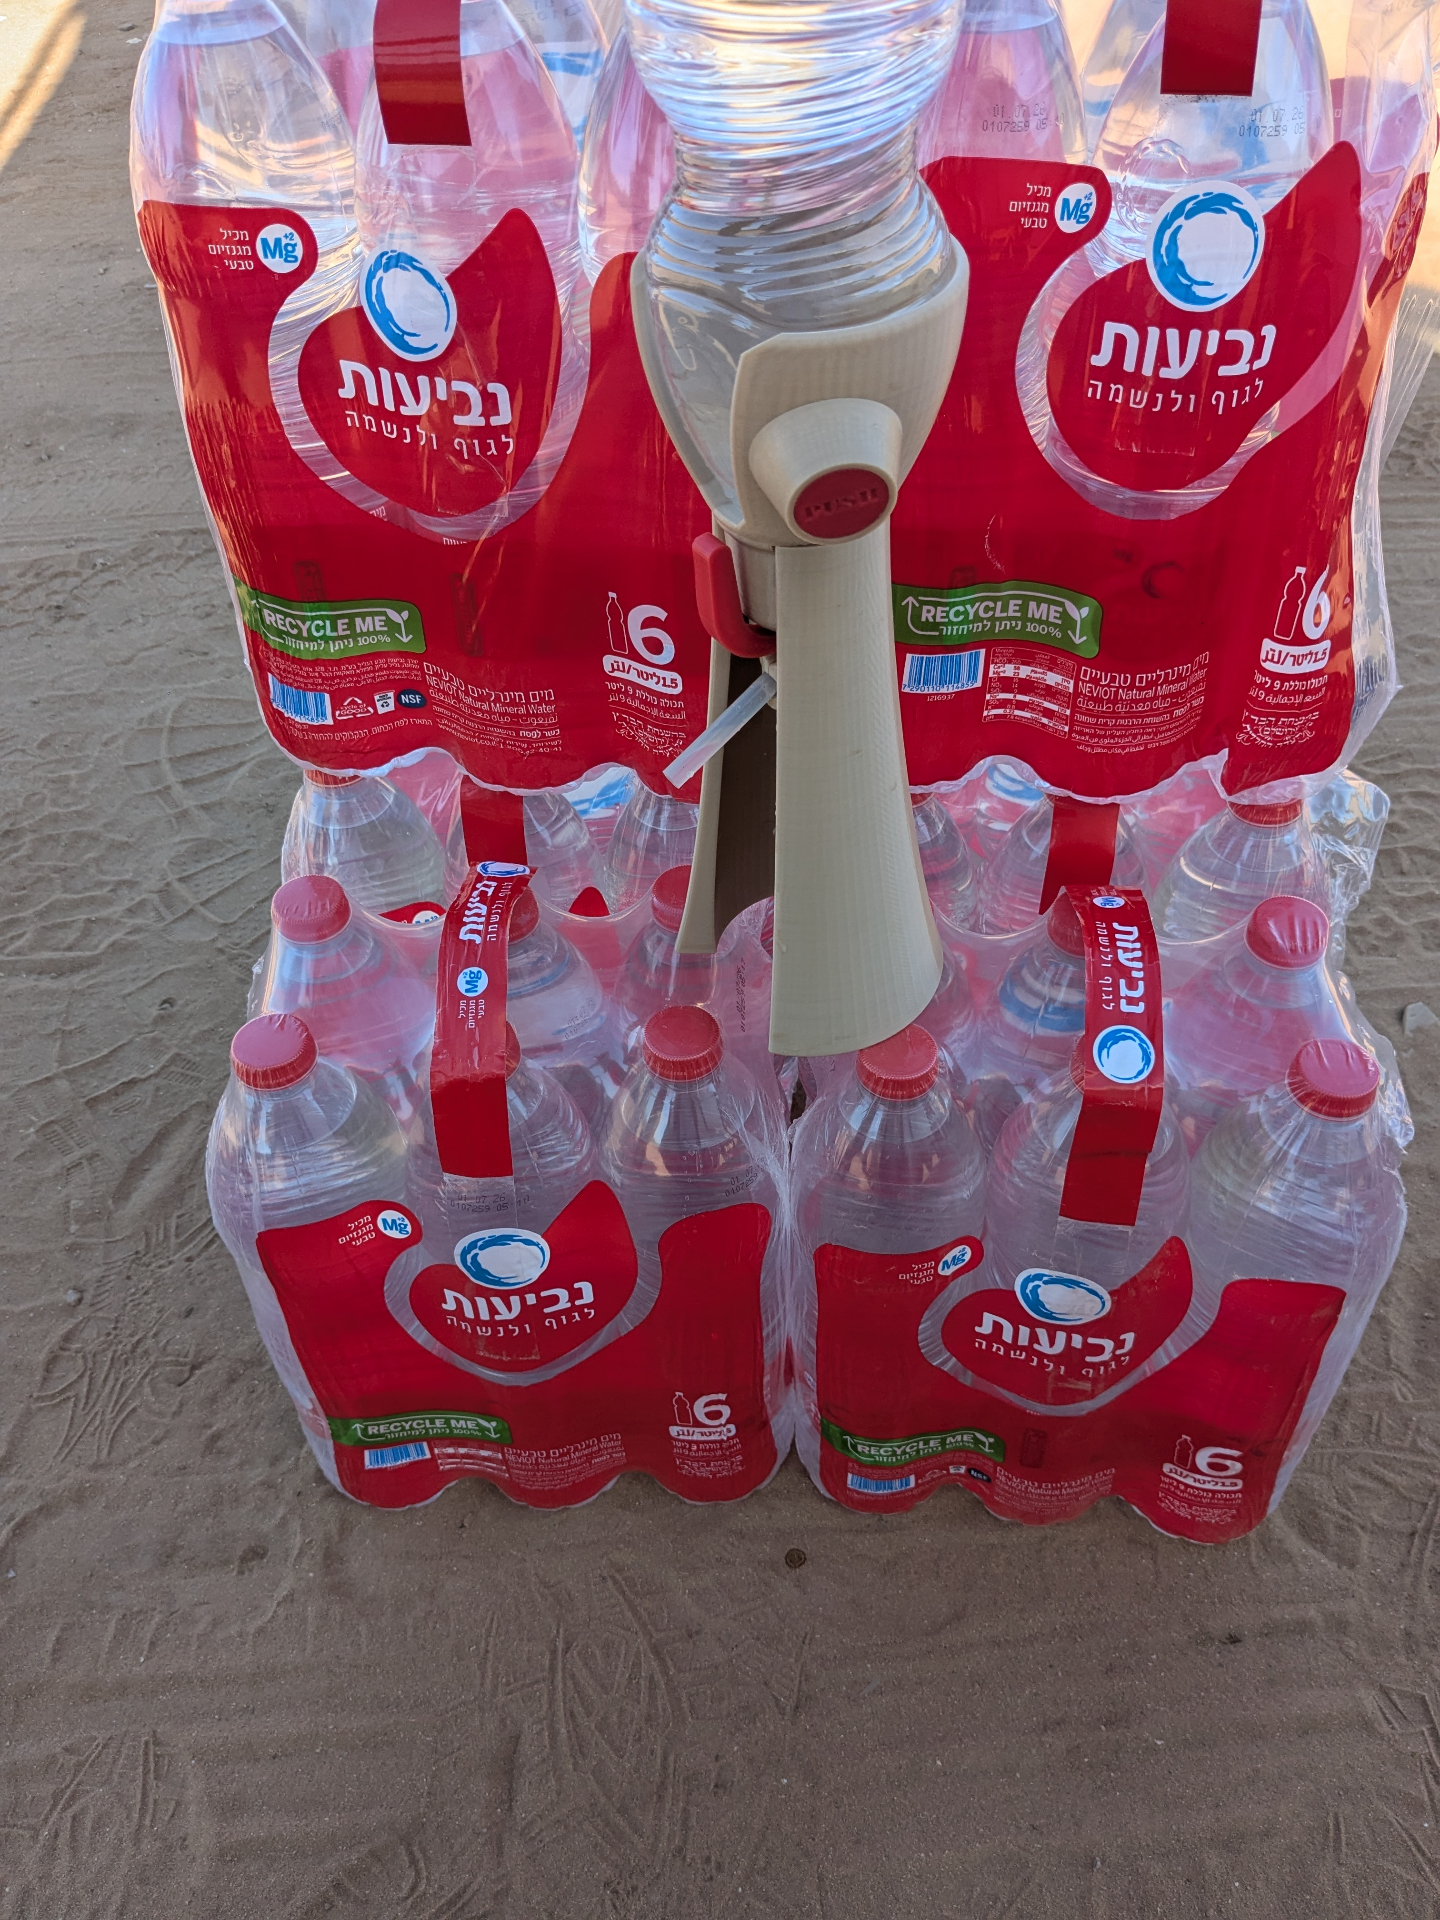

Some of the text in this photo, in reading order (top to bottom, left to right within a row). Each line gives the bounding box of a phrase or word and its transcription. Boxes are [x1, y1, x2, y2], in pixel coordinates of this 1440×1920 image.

[982, 120, 1030, 133] 0107259
[1239, 124, 1287, 137] 0107259
[1026, 182, 1052, 197] מכיל
[1009, 201, 1049, 213] מגנזיום
[1020, 217, 1048, 229] טבעי
[219, 227, 249, 241] מכיל
[208, 244, 252, 256] מגנזיום
[224, 259, 254, 270] טבעי
[1090, 321, 1277, 380] נביעות
[338, 359, 512, 426] נביעות
[1087, 377, 1264, 415] לגוף ולנשמה
[345, 410, 514, 459] לגוף ולנשמה
[1302, 565, 1331, 640] 6
[920, 600, 1063, 624] RECYCLE ME
[263, 608, 388, 637] RECYCLE ME
[939, 620, 1062, 639] 100% ניתן למיחזור
[282, 634, 391, 652] 100% ניתן למיחזור
[627, 604, 675, 665] 6
[423, 661, 465, 690] טבעיים
[1080, 651, 1210, 687] מים מינרליים טבעיים
[425, 674, 457, 697] NEVIOT
[458, 689, 490, 711] Natural
[491, 702, 527, 714] Mineral
[528, 703, 556, 714] Water
[468, 684, 526, 703] מינרליים
[909, 684, 940, 692] 290110
[1078, 681, 1117, 700] NEVIOT
[1118, 686, 1155, 700] Natural
[1156, 676, 1189, 696] Mineral
[1273, 680, 1280, 690] 9
[401, 694, 422, 704] NSF
[529, 689, 555, 702] מים
[605, 681, 684, 709] תכולה כוללת 9 ליטר
[620, 694, 626, 703] 9
[1258, 690, 1265, 701] 9
[341, 708, 367, 716] GOOD
[1074, 713, 1097, 724] שמונה
[1172, 702, 1191, 718] לפסח
[395, 717, 409, 728] לפח
[1097, 718, 1115, 727] קרית
[519, 729, 542, 738] לפסח
[459, 880, 498, 945] נביעות
[486, 899, 505, 942] ולנשמה
[1095, 921, 1115, 1011] לגוף ולנשמה
[1112, 922, 1145, 1014] נביעות
[458, 1000, 467, 1019] מכיל
[468, 1000, 476, 1029] מגנזיום
[450, 1200, 491, 1213] 0107259
[347, 1215, 372, 1231] מכיל
[338, 1223, 374, 1244] מגנזיום
[351, 1231, 376, 1246] טבעי
[898, 1268, 934, 1279] מגנזיום
[912, 1261, 935, 1270] מכיל
[910, 1276, 933, 1285] טבעי
[441, 1281, 594, 1321] נביעות
[446, 1308, 595, 1337] לגוף ולנשמה
[974, 1312, 1135, 1362] נביעות
[974, 1338, 1130, 1378] לגוף ולנשמה
[693, 1393, 731, 1426] 6
[367, 1419, 479, 1435] RECYCLE ME
[384, 1428, 482, 1440] 100% ניתן למיחזור
[504, 1432, 622, 1458] מים מינרליים טבעיים
[505, 1440, 622, 1464] NEVIOT Natural Mineral Water
[856, 1434, 974, 1456] RECYCLE ME
[919, 1446, 942, 1456] ניתן
[1195, 1446, 1243, 1477] 6
[1027, 1486, 1060, 1495] Natural
